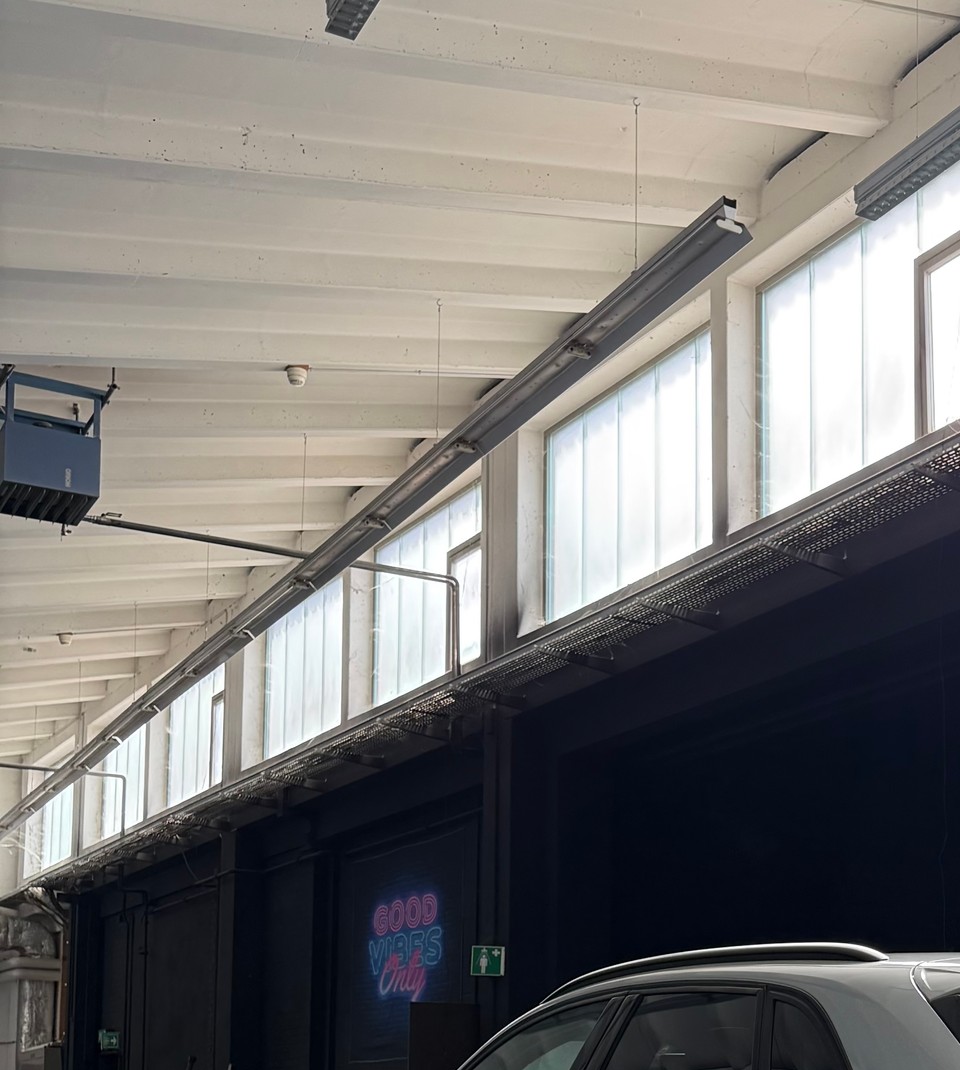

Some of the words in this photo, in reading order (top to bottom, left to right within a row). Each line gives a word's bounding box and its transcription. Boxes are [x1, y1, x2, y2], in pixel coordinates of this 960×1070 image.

[374, 894, 438, 936] GOOD
[368, 926, 442, 975] VIBES
[379, 948, 427, 1002] Only
